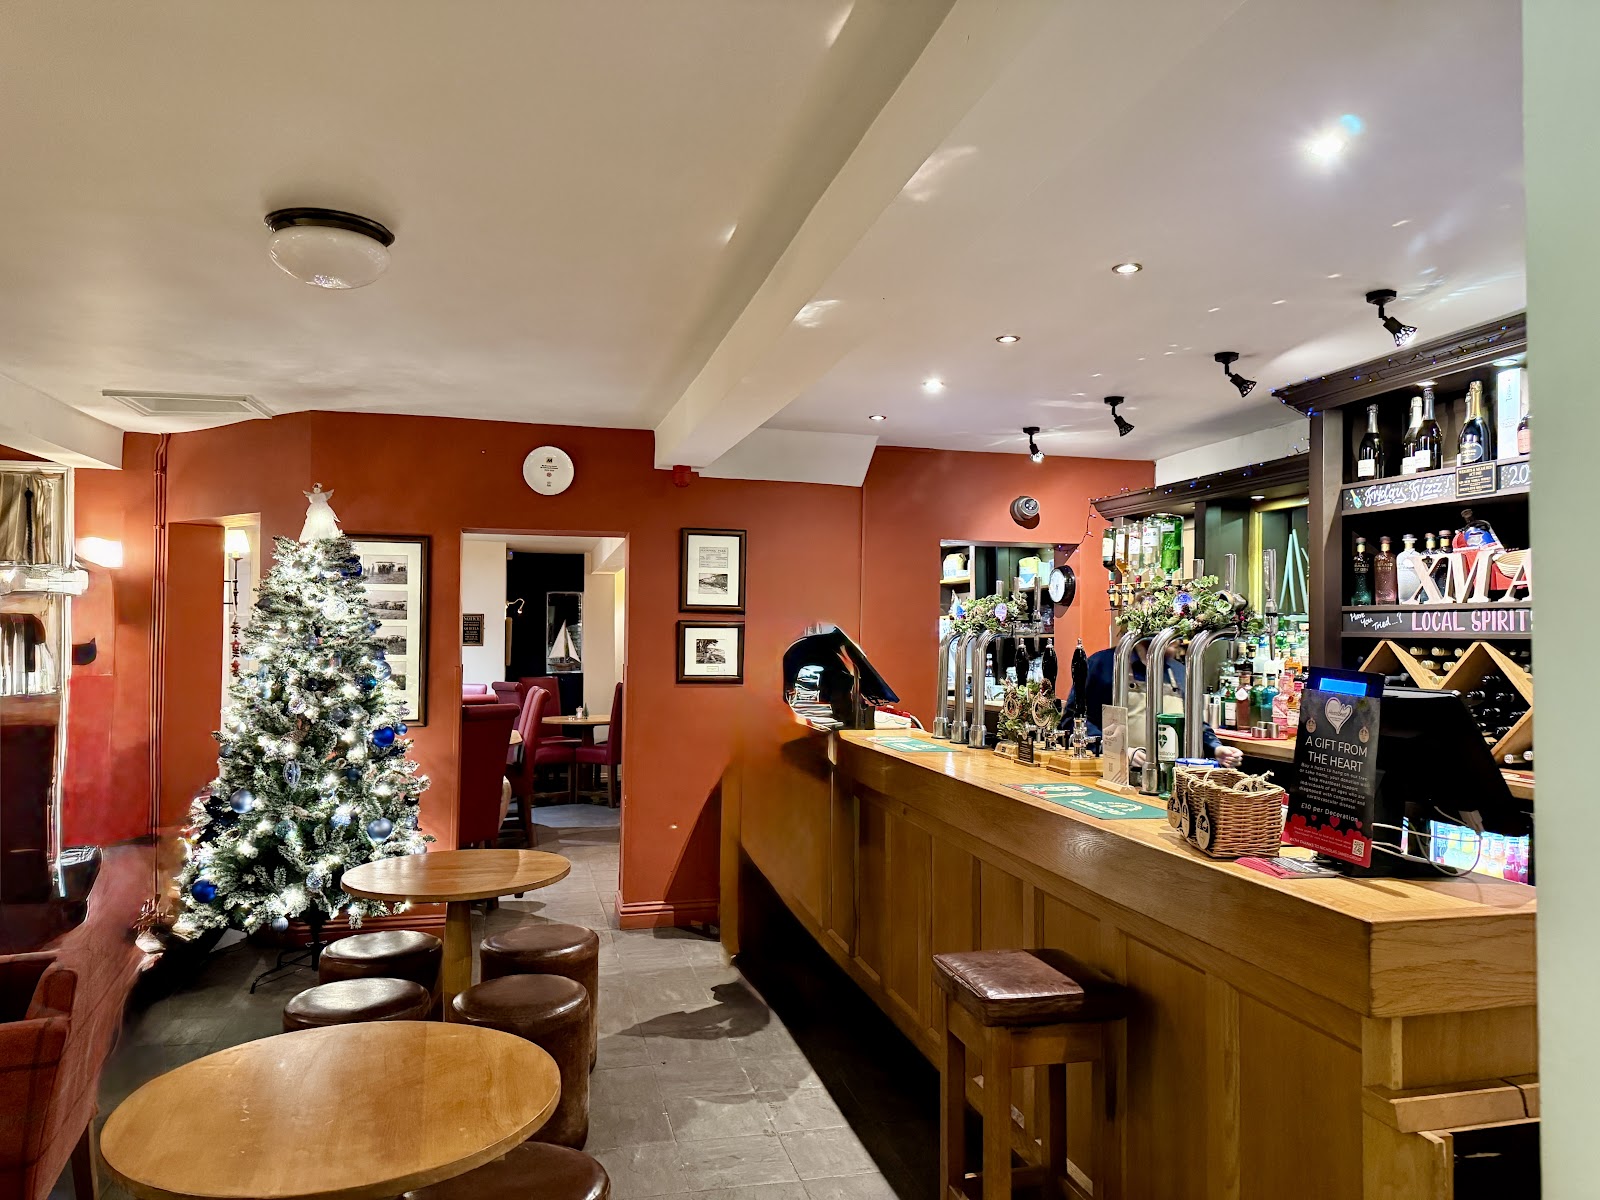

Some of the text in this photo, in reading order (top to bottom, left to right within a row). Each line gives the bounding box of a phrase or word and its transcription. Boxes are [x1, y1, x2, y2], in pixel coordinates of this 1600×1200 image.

[1364, 484, 1410, 507] Friday
[1350, 612, 1366, 622] Have
[1360, 617, 1374, 628] You
[1411, 610, 1466, 632] LOCAL
[1305, 735, 1368, 758] A GIFT FROM
[1308, 750, 1364, 773] THE HEART
[1301, 802, 1312, 811] £10
[1324, 808, 1359, 823] Decoration
